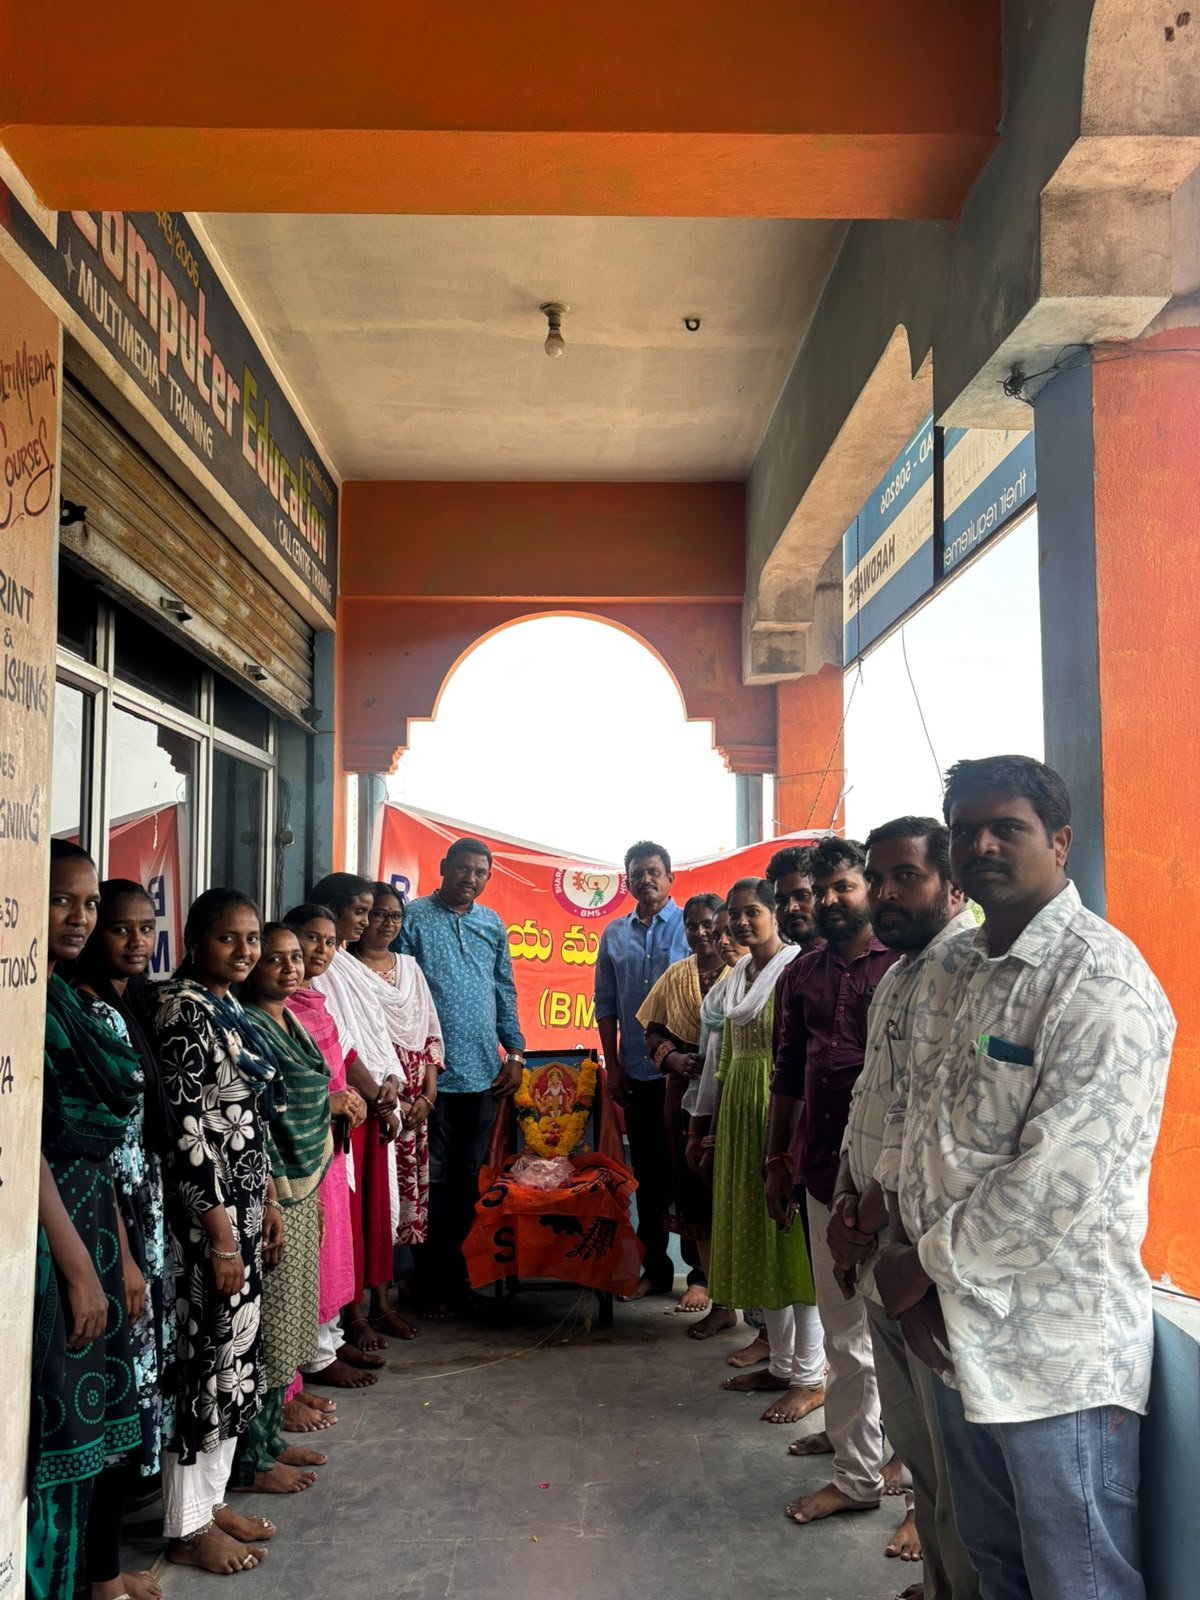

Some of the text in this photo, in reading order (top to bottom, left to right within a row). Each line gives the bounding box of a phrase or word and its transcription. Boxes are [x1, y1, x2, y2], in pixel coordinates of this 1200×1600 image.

[77, 259, 213, 460] MULTIMEDIA TRAINING
[242, 363, 327, 566] Education
[278, 518, 292, 557] CALL
[4, 627, 14, 649] &
[580, 909, 601, 917] BMS
